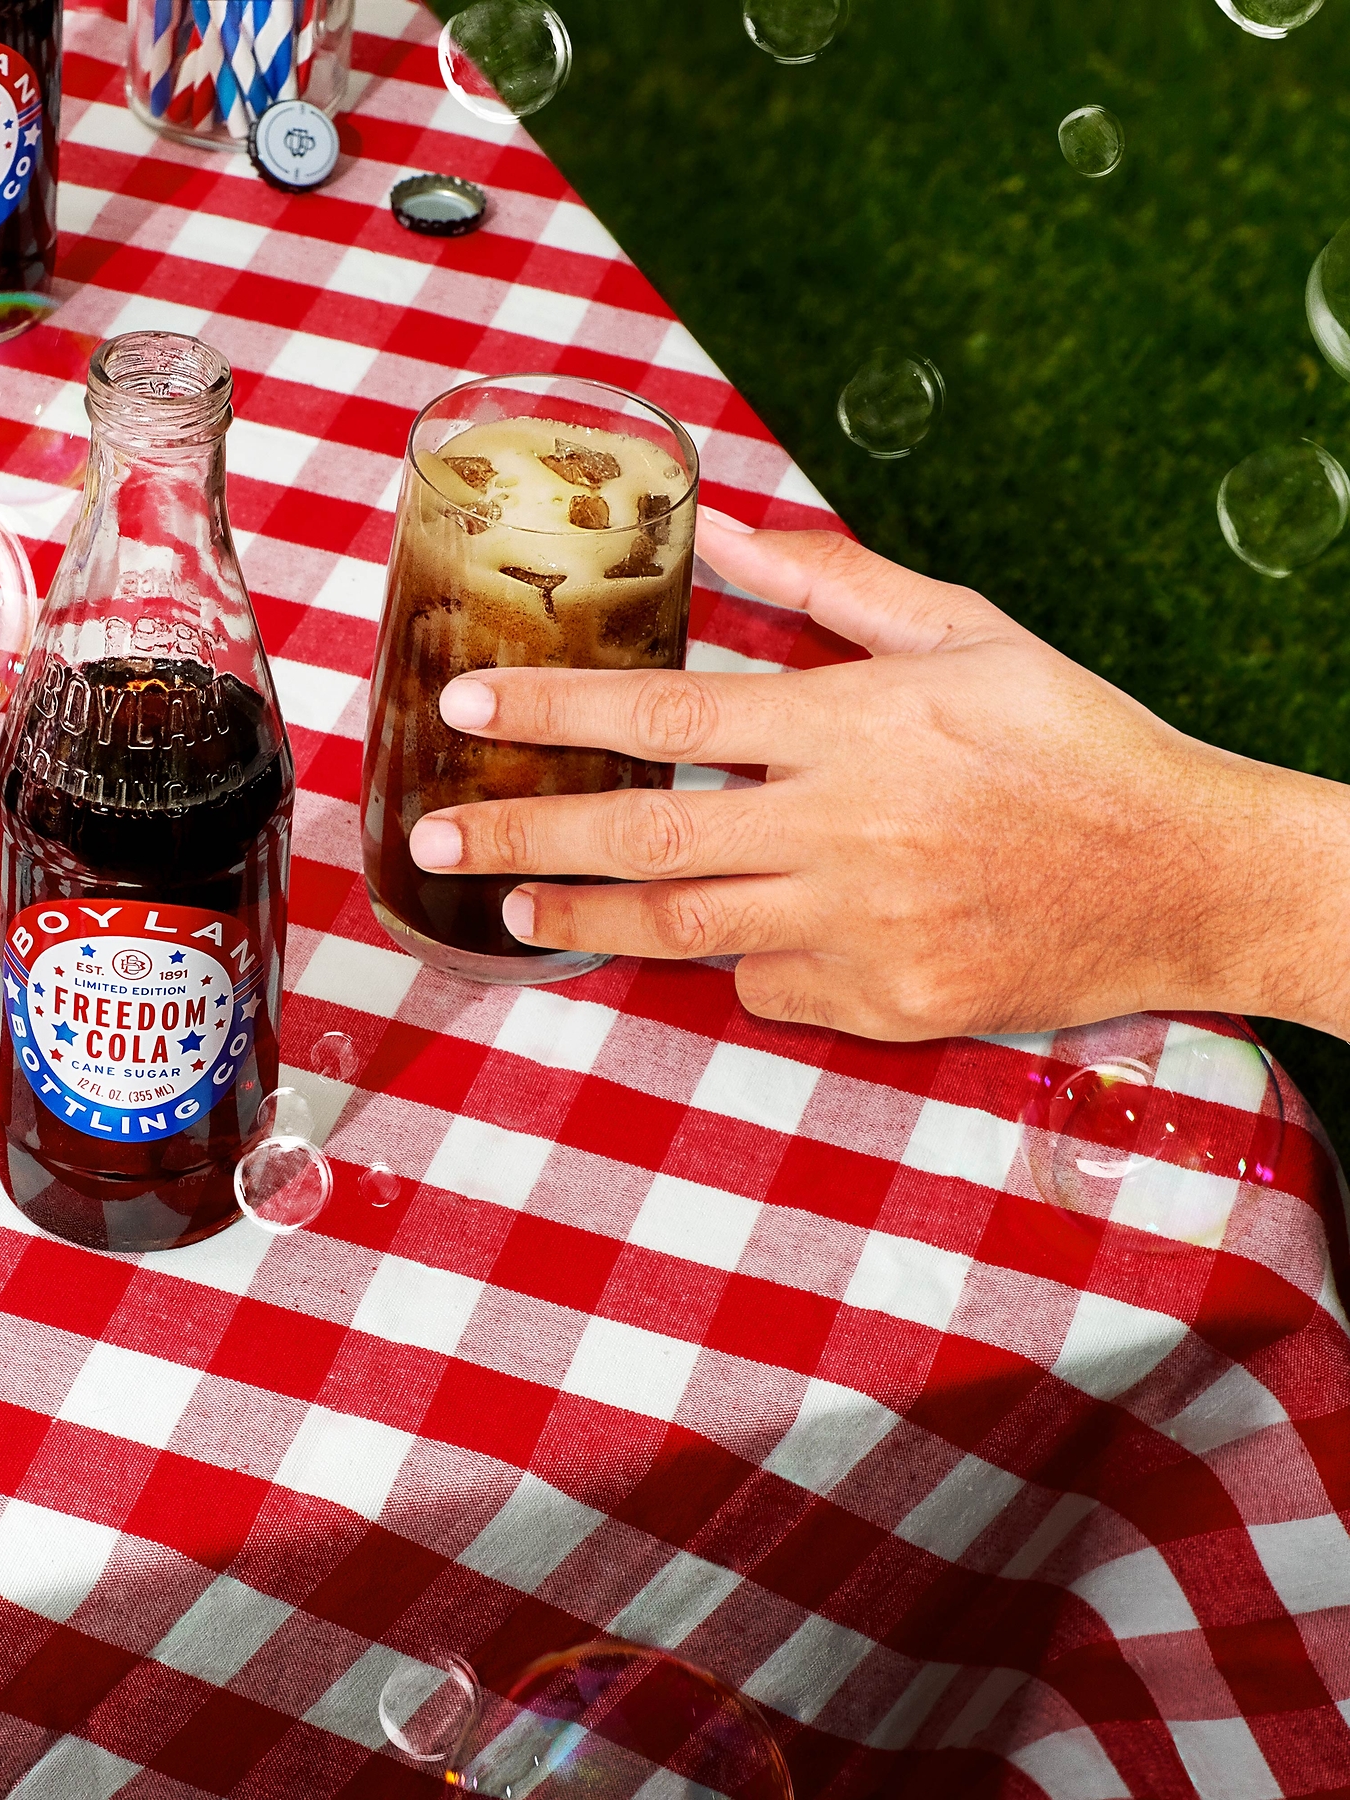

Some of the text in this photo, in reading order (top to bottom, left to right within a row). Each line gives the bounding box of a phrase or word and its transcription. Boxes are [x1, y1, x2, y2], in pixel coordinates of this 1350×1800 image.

[3, 156, 31, 200] CO
[11, 906, 256, 974] BOYLAN
[74, 977, 186, 996] LIMITED EDITION
[76, 962, 188, 981] EST. 1891
[54, 986, 207, 1031] FREEDOM
[86, 1029, 169, 1064] COLA
[11, 1015, 248, 1134] BOTTLING CO
[71, 1060, 181, 1078] CANE SUGAR
[77, 1077, 175, 1103] 12 FL. OZ. (355 ML)
